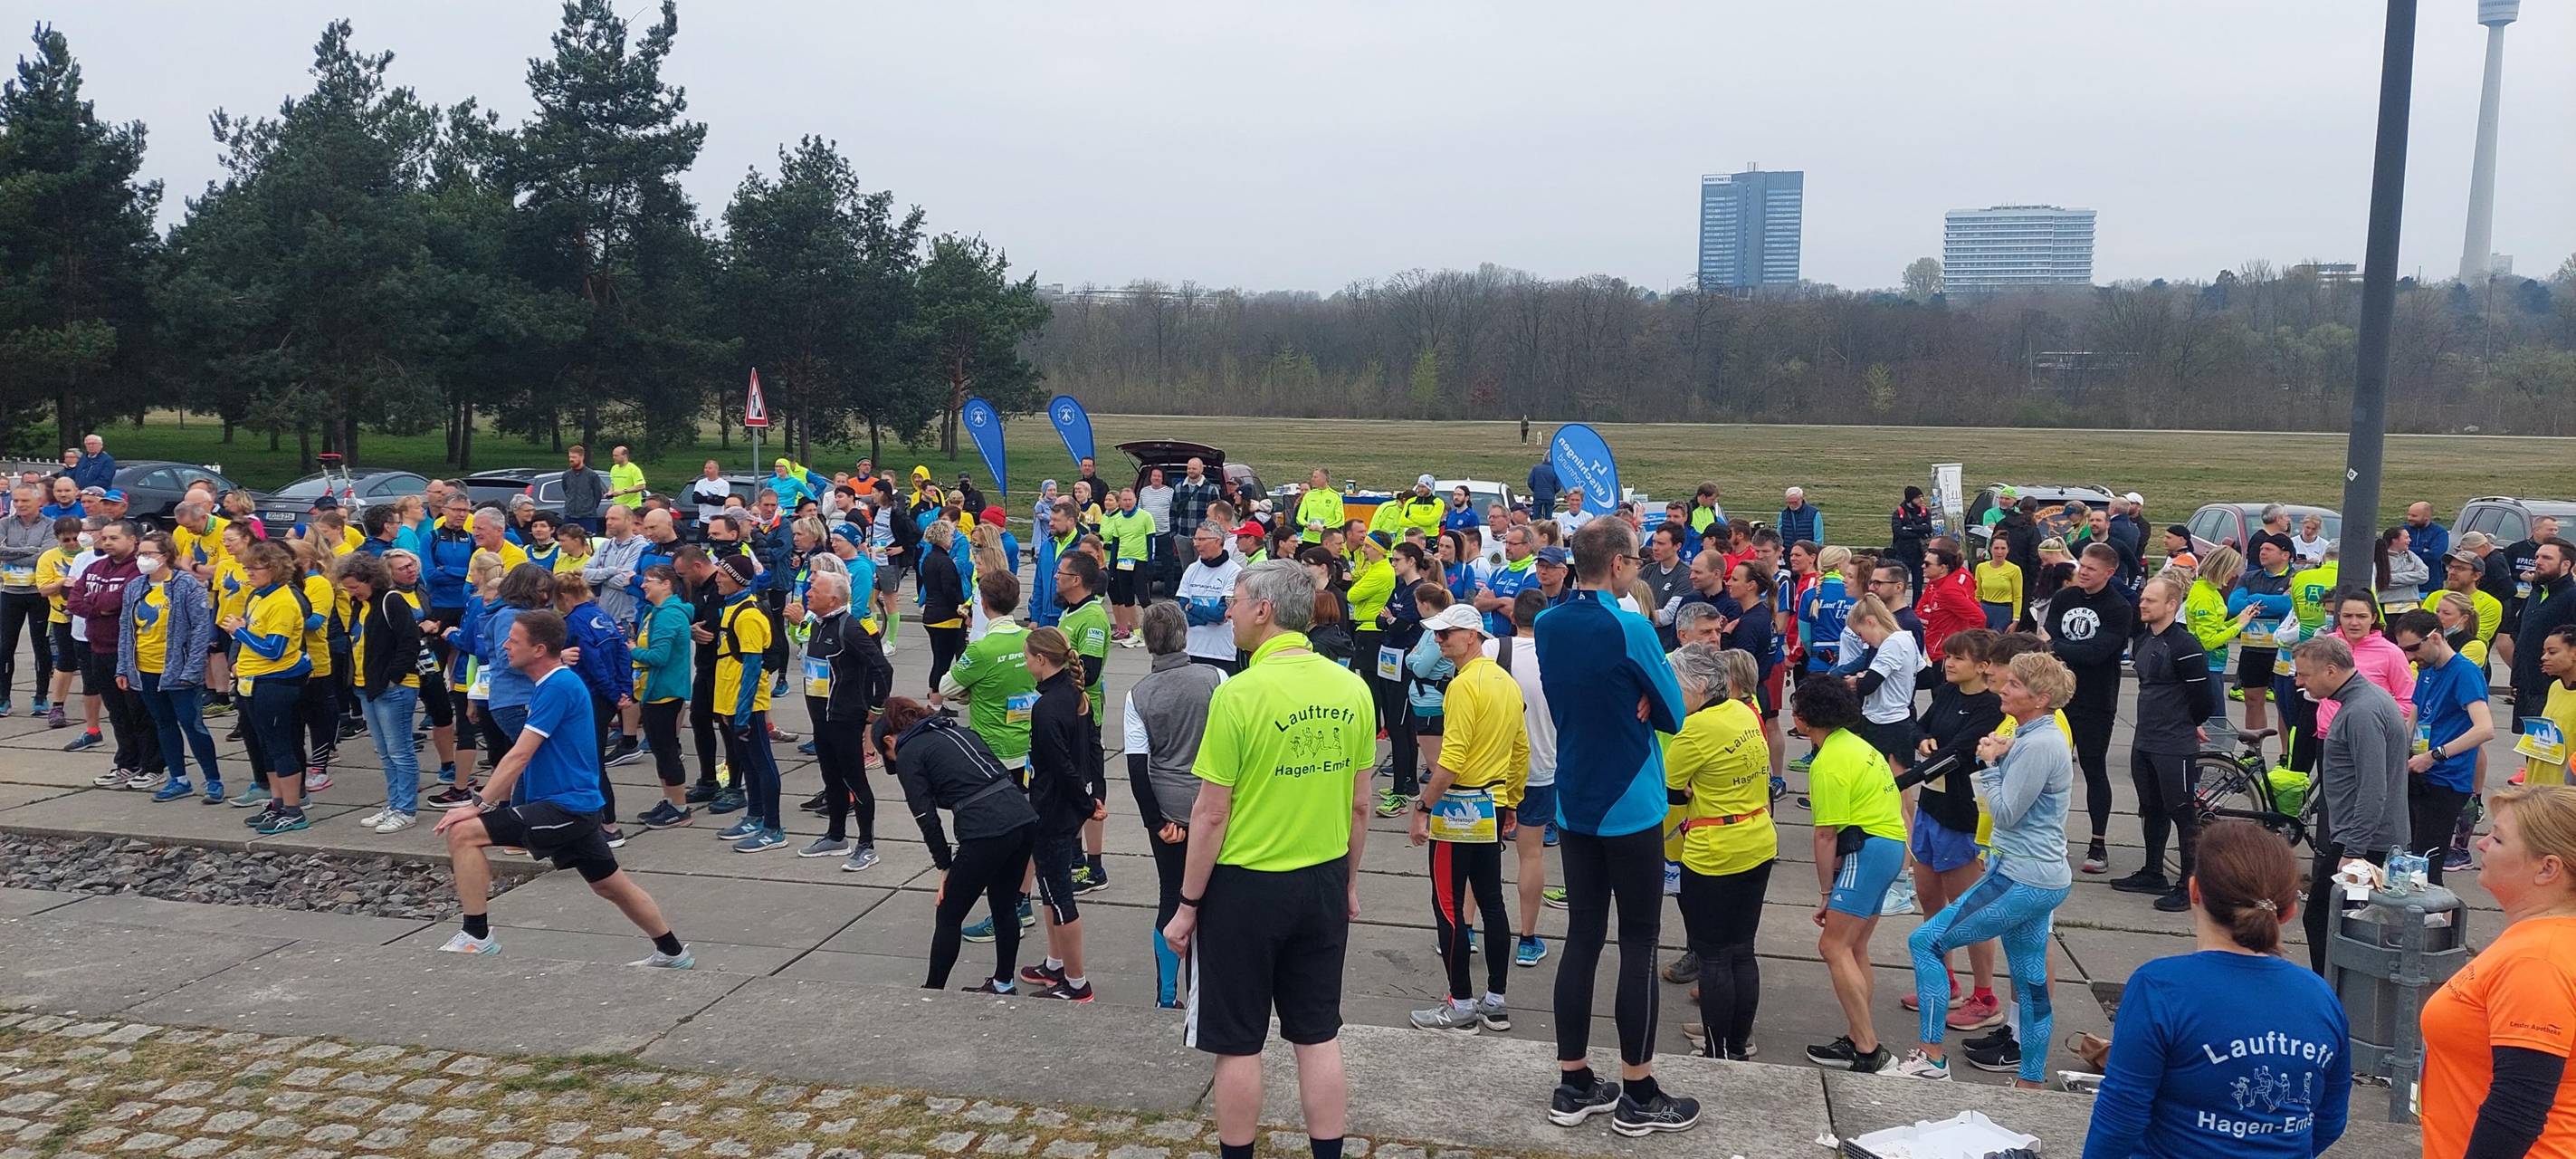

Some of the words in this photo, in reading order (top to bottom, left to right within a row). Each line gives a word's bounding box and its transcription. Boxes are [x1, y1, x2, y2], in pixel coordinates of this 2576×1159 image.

[2515, 557, 2537, 566] #PACE
[1835, 609, 1847, 619] Un
[1837, 599, 1855, 609] Tea
[1274, 705, 1354, 733] Lauftreff
[1724, 728, 1760, 754] Lauftre
[1732, 765, 1770, 787] Hagen-E
[2202, 1030, 2333, 1068] Lauftreff
[2197, 1110, 2315, 1138] Hagen-Ems
